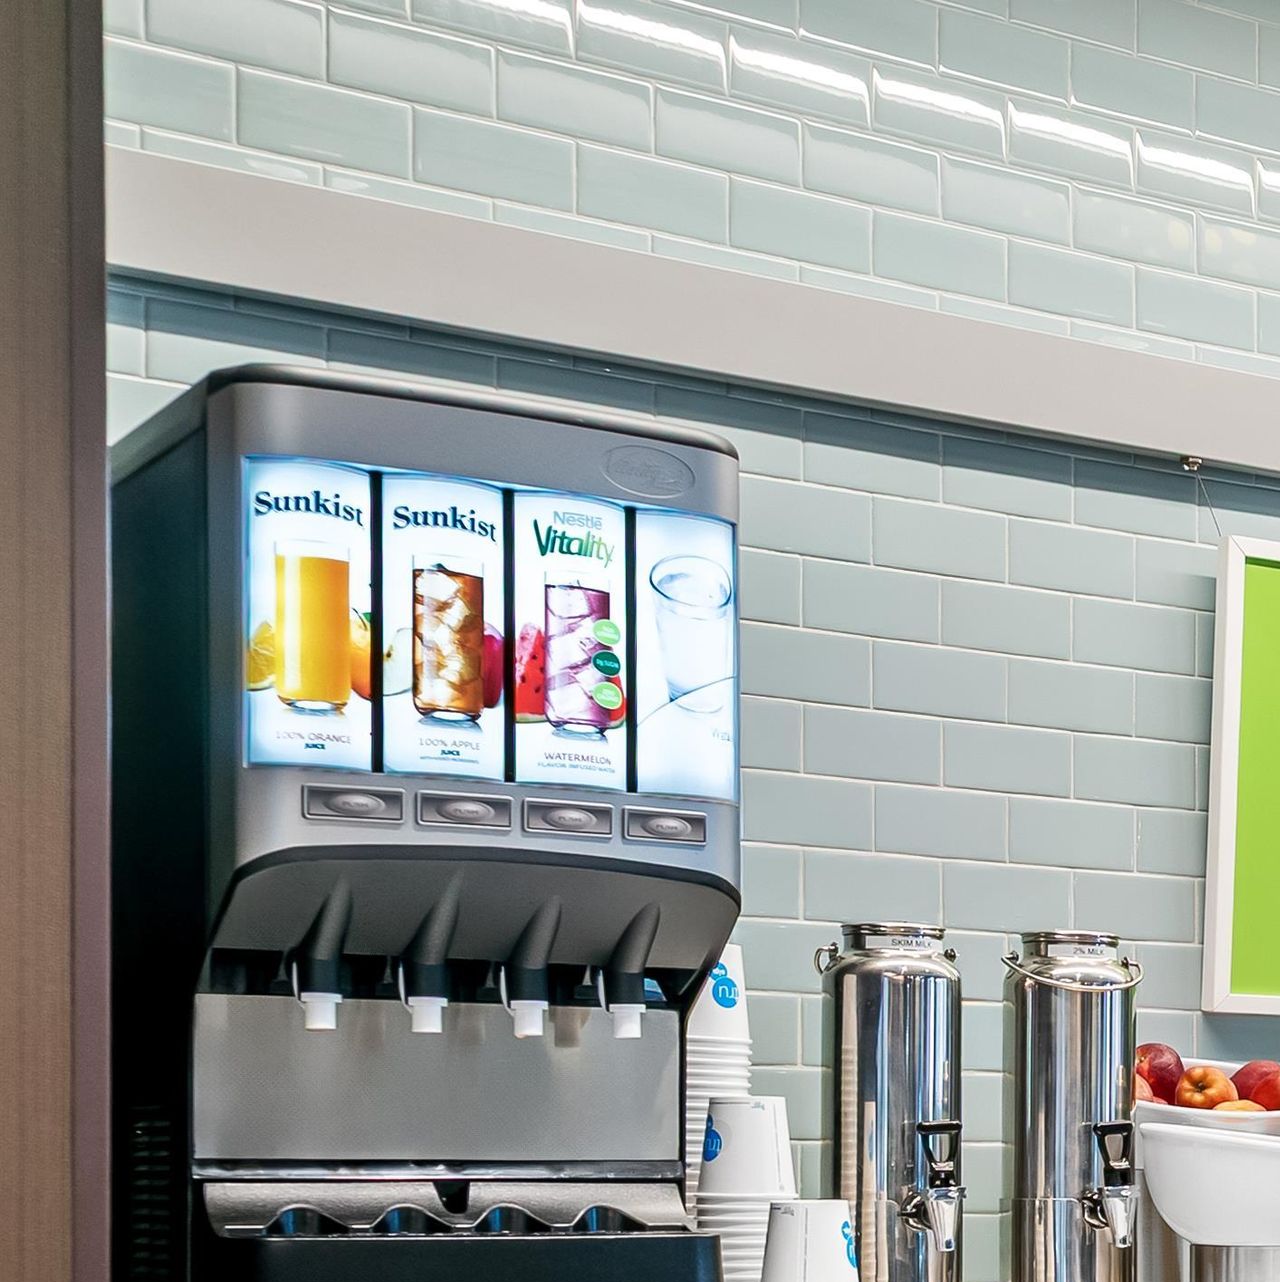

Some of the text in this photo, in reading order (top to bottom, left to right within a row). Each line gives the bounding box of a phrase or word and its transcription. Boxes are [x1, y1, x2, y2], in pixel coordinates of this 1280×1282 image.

[254, 490, 365, 527] Sunkist
[392, 505, 497, 542] Sunkist
[553, 510, 603, 531] Nestlé
[533, 519, 615, 569] Vitality
[307, 732, 352, 744] ORANGE
[419, 738, 480, 751] 100% APPLE
[544, 752, 612, 766] WATERMELON
[891, 938, 914, 948] SKIM
